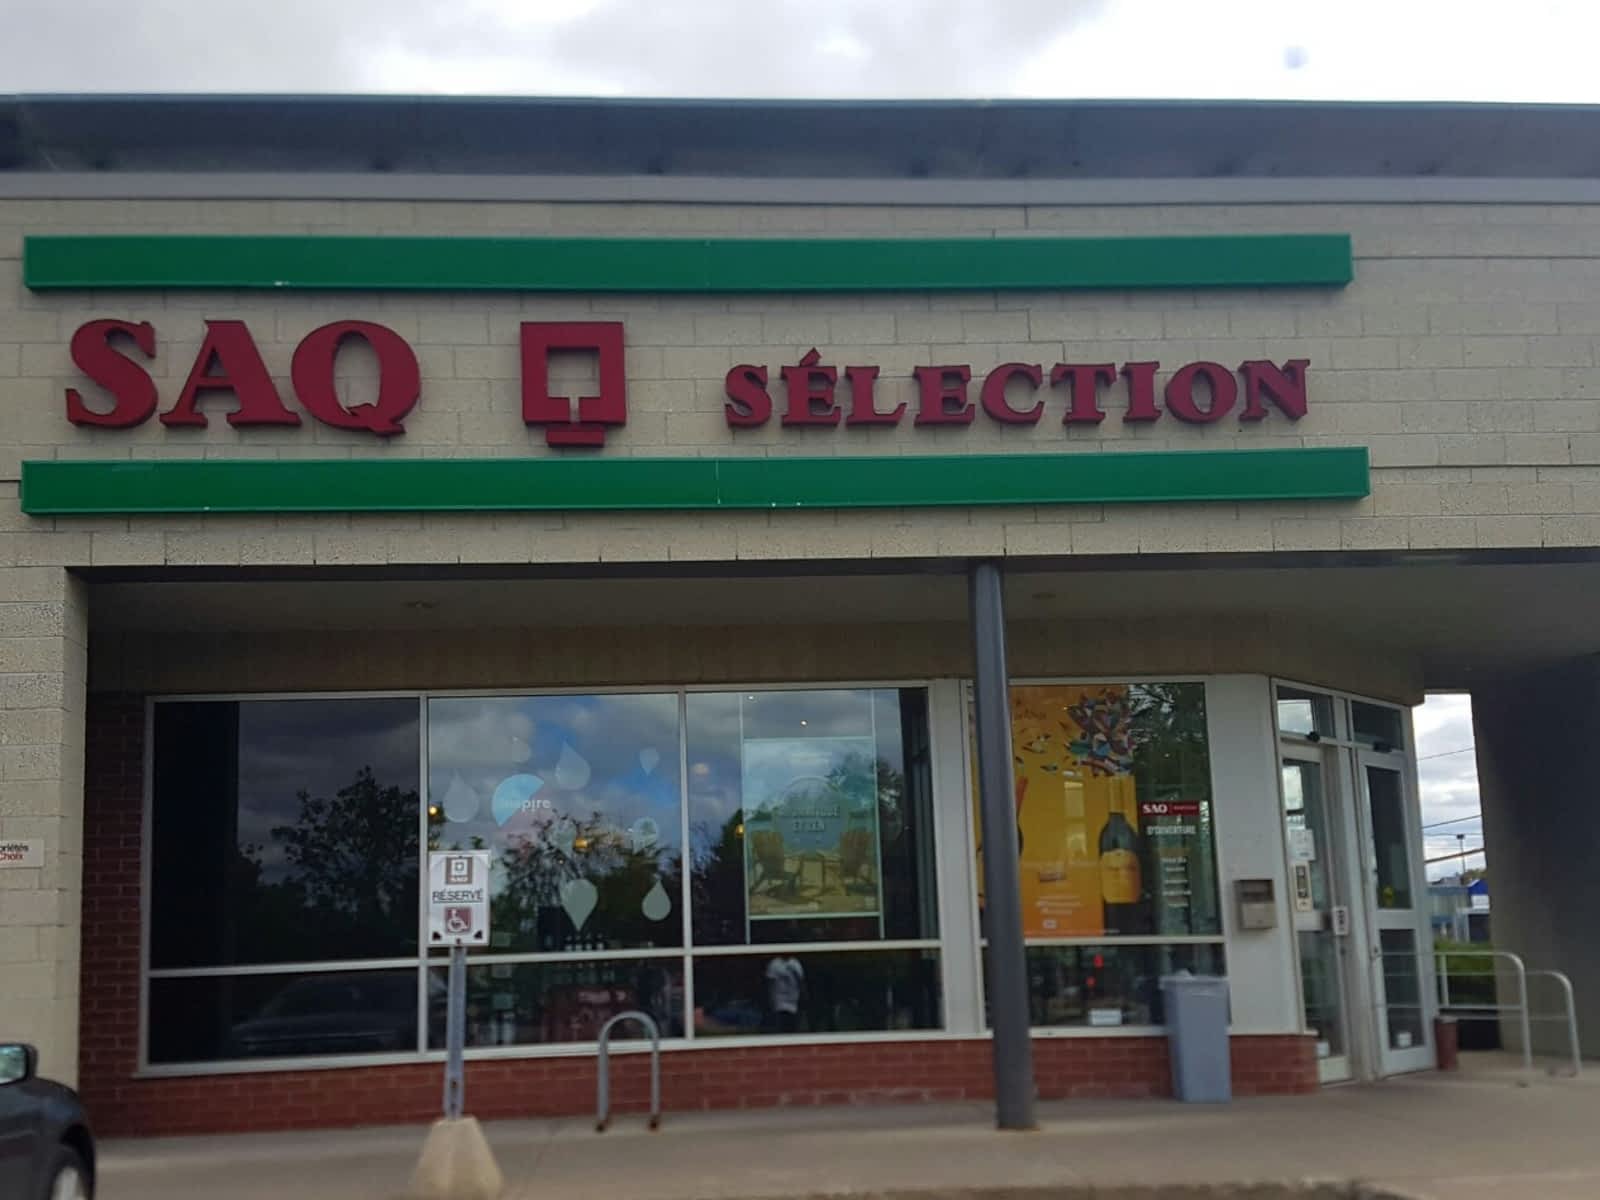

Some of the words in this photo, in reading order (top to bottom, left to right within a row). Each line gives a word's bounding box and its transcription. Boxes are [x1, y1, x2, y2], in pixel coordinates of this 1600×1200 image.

[65, 318, 421, 436] SAQ
[724, 347, 1311, 428] SÉLECTION
[432, 887, 484, 901] RÉSERVÉ
